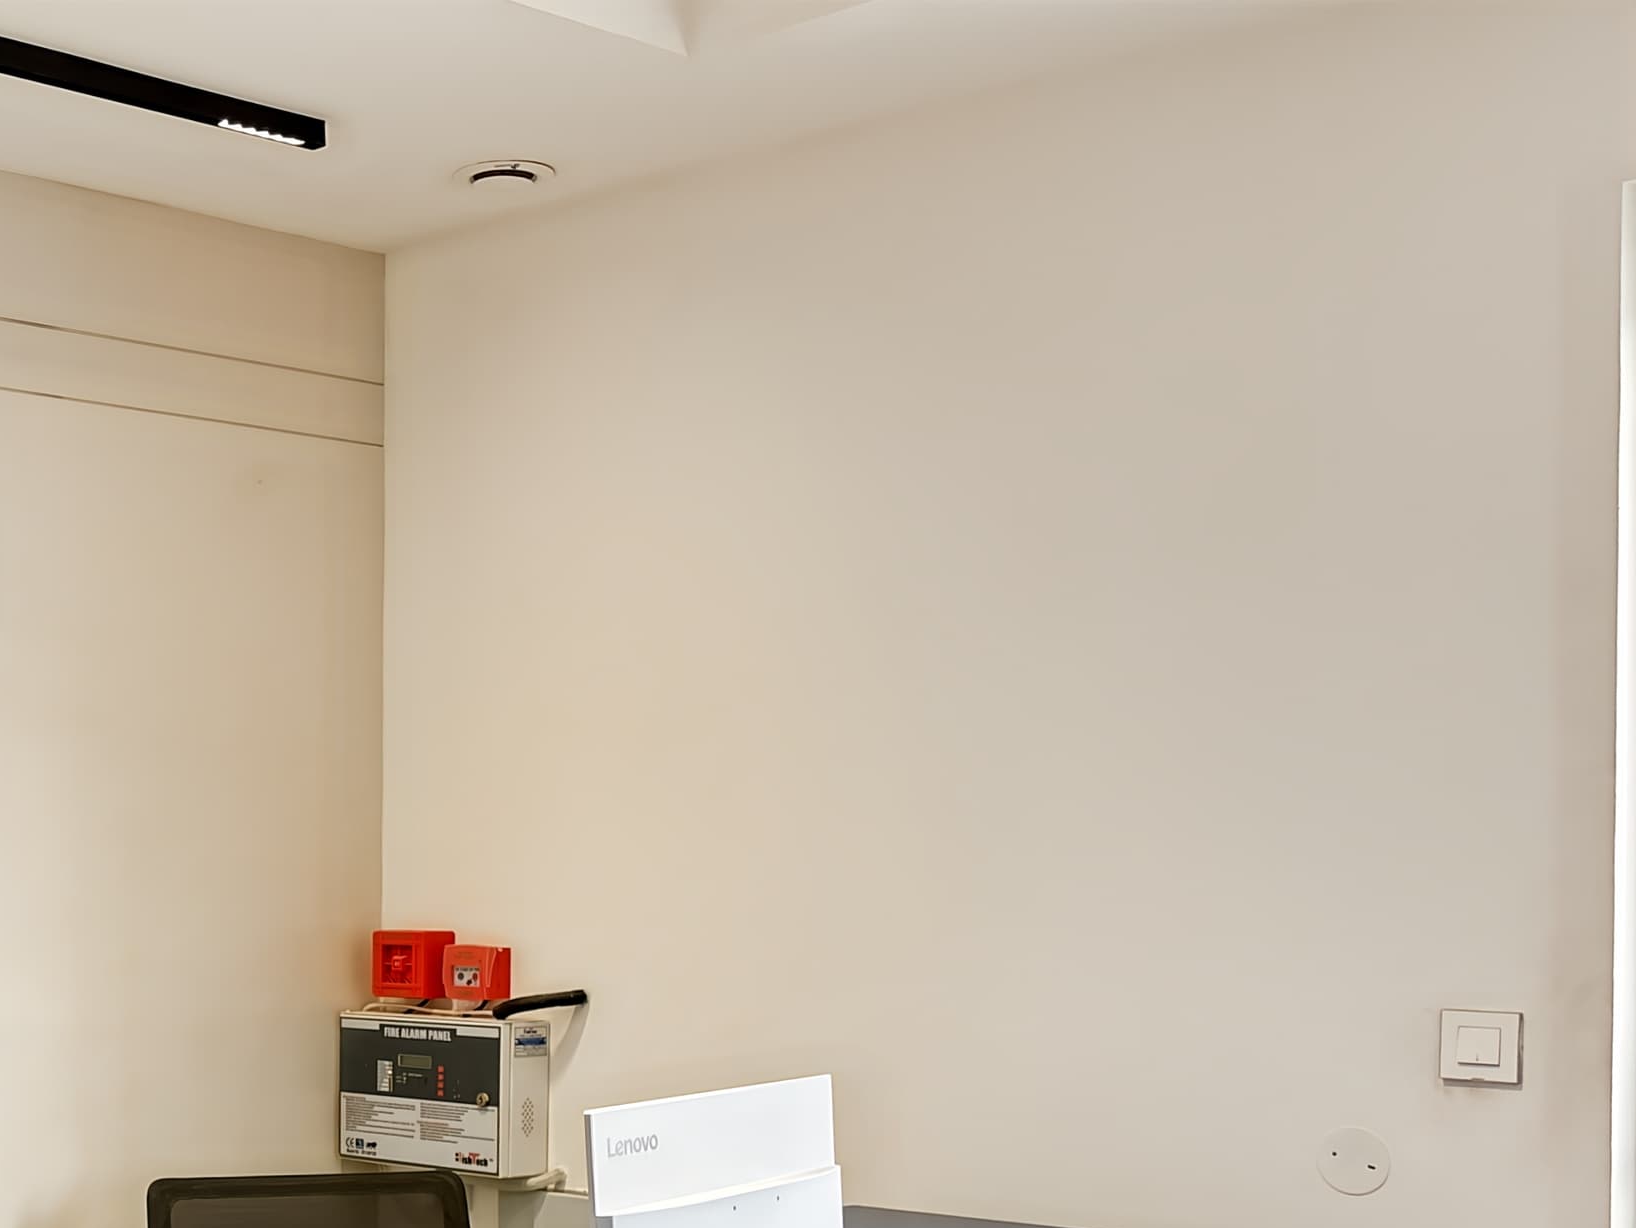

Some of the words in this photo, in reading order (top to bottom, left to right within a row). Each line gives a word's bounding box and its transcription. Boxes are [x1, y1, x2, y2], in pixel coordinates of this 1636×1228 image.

[384, 1026, 400, 1038] FIRE
[401, 1027, 427, 1040] ALARM
[428, 1029, 452, 1042] PANEL
[607, 1134, 659, 1158] Lenovo
